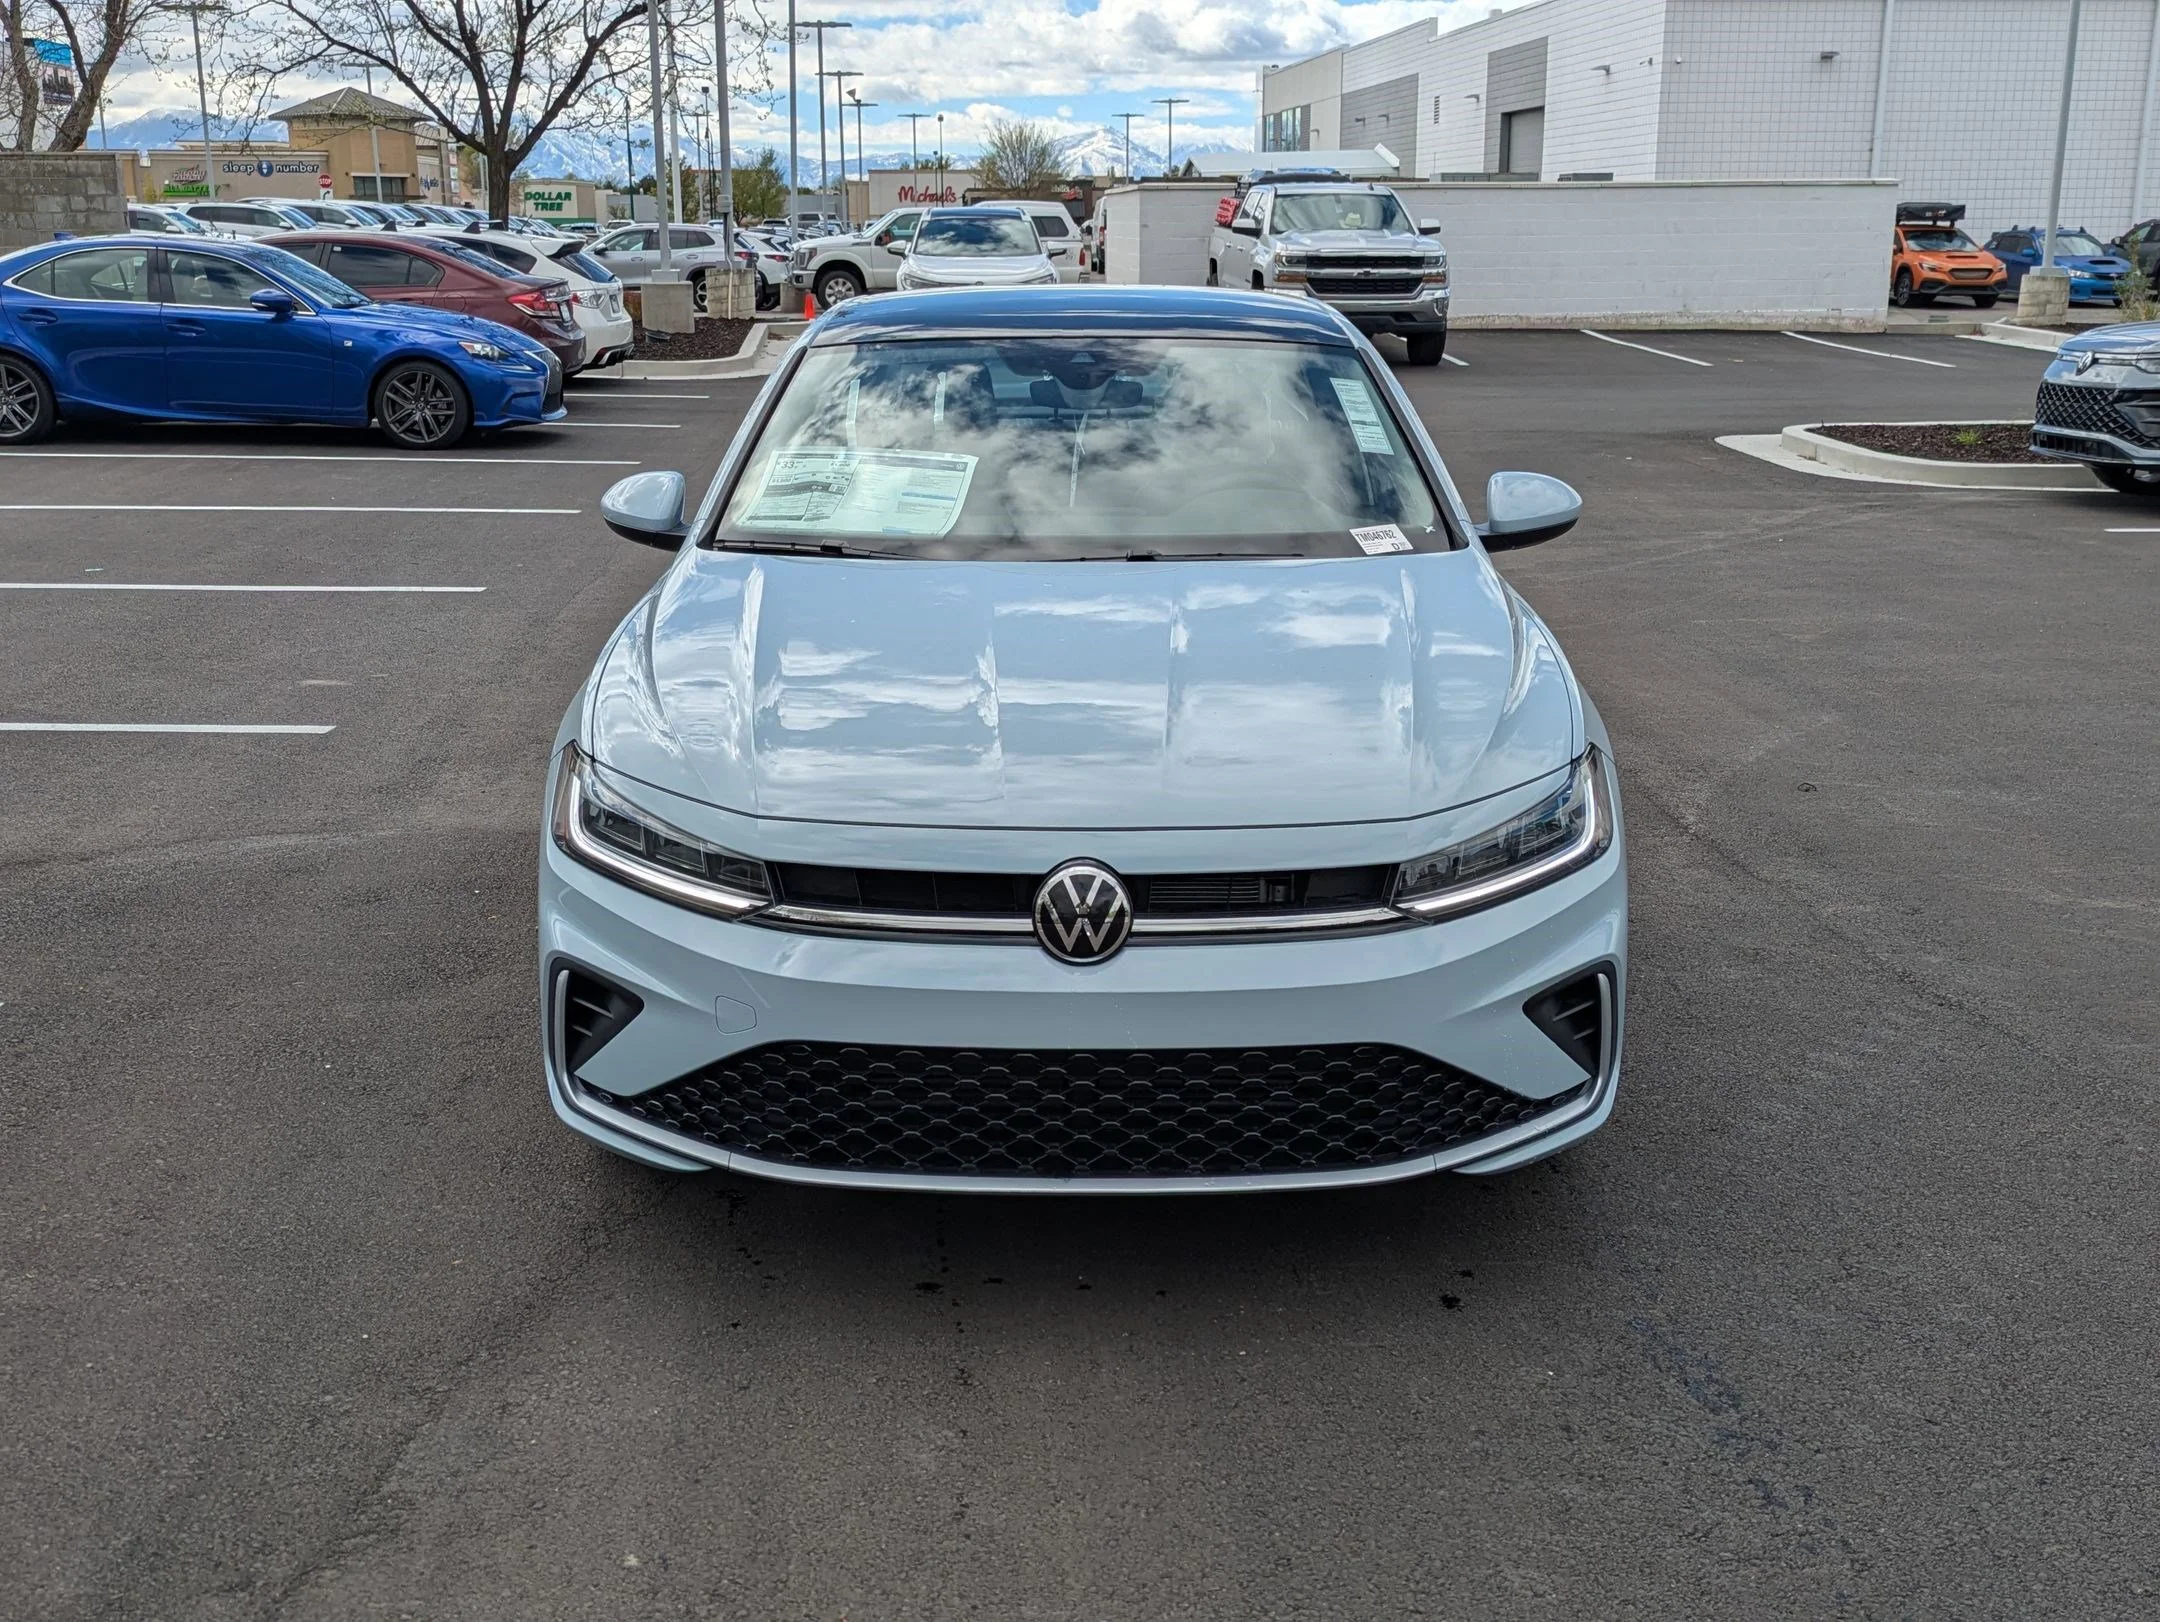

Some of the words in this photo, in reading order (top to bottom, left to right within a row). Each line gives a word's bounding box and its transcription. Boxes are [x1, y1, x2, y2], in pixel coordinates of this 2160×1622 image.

[223, 161, 254, 176] sleep
[276, 161, 319, 174] number
[319, 178, 332, 186] STOP
[524, 191, 572, 201] DOLLAR
[898, 185, 957, 203] Michaels
[534, 202, 563, 212] TREE
